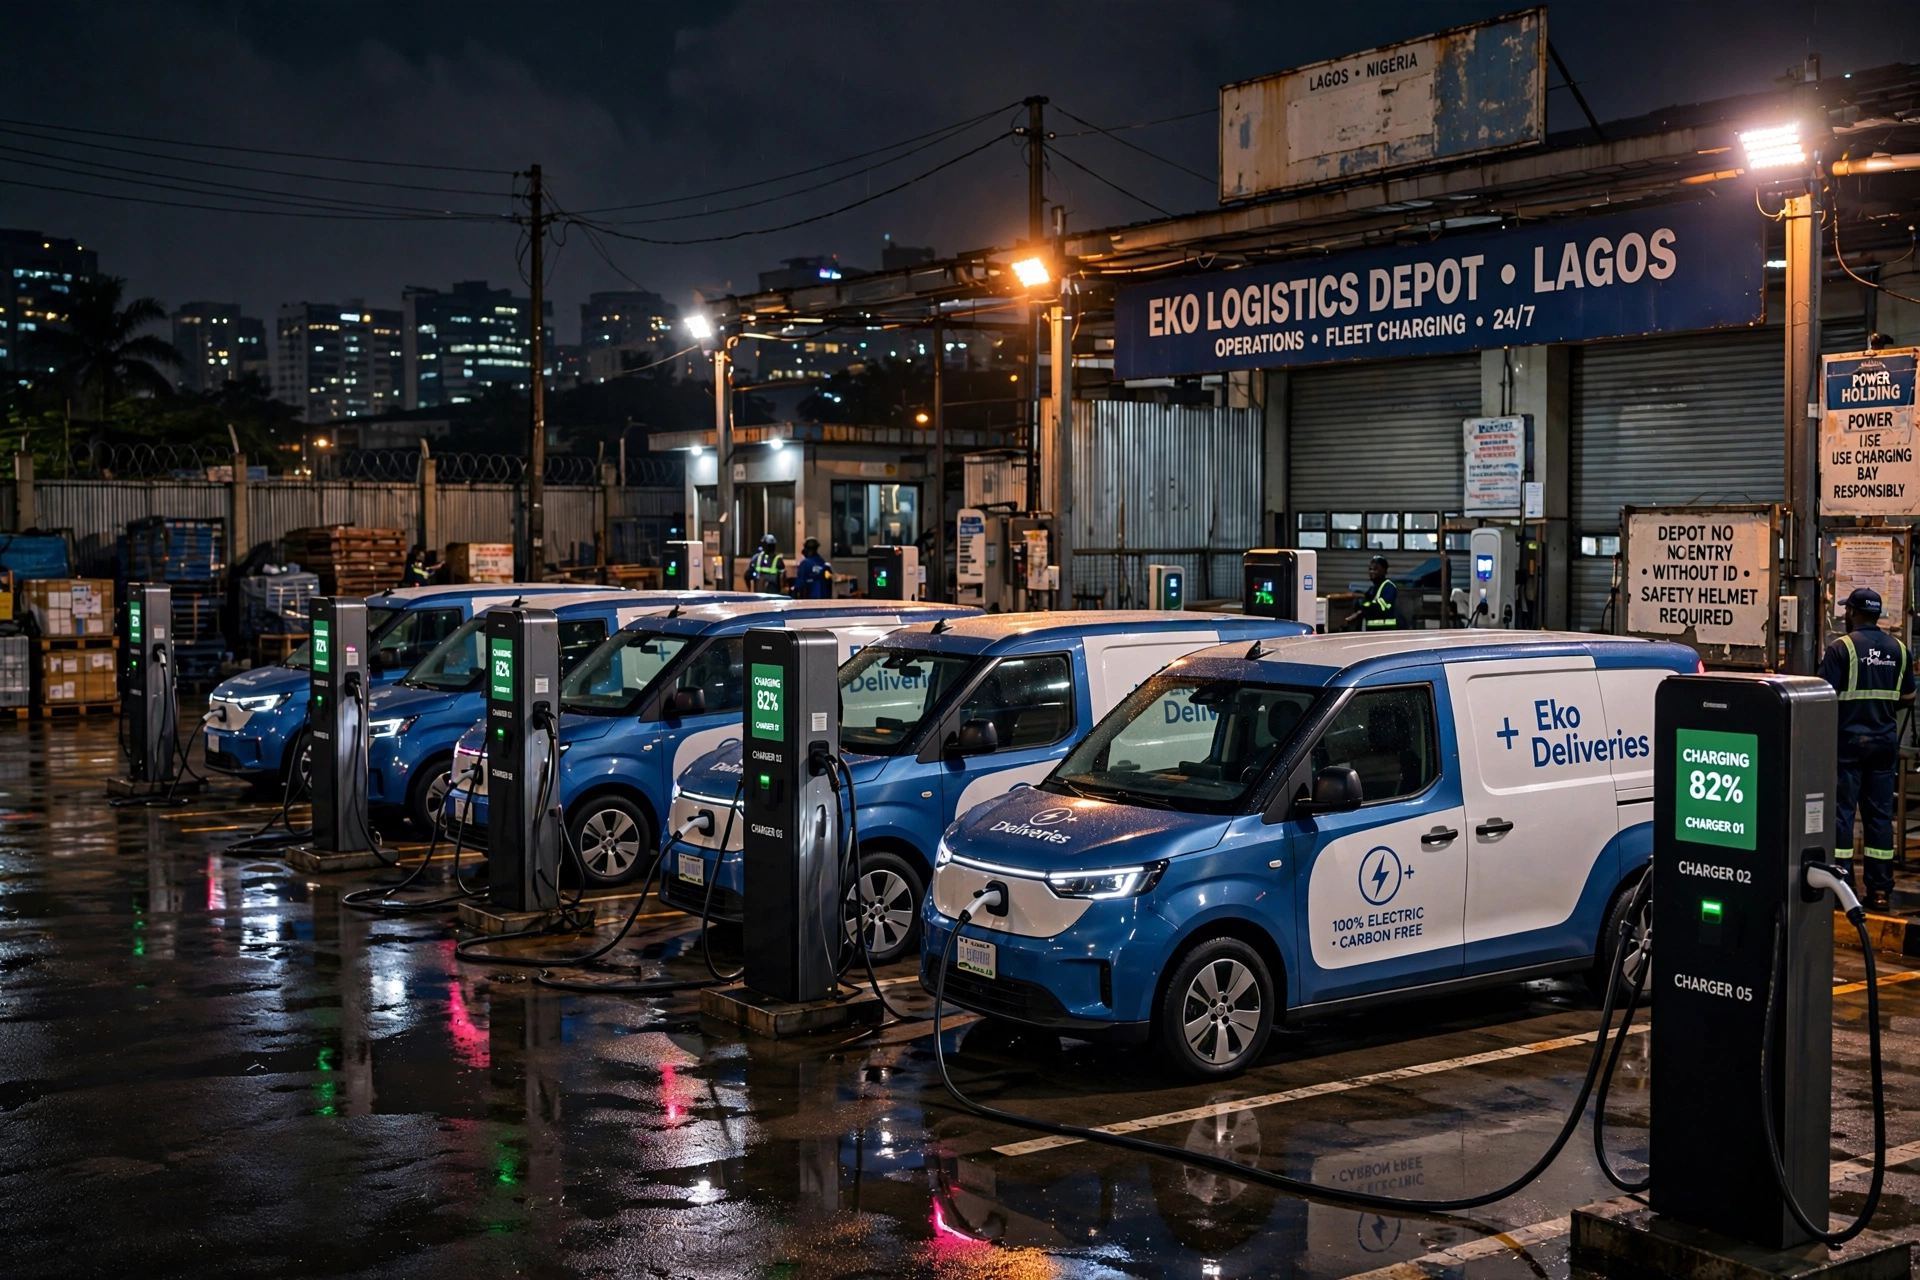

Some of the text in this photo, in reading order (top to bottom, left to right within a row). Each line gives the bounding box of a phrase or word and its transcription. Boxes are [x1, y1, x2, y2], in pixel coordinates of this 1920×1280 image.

[1309, 52, 1418, 91] LAGOS NIGERIA
[1149, 227, 1677, 337] EKO LOGISTICS DEPOT LAGOS
[1214, 304, 1536, 358] OPERATIONS FLEET CHARGING 24/7
[1852, 370, 1891, 388] POWER
[1841, 384, 1901, 403] HOLDING
[1848, 412, 1893, 430] POWER
[1832, 448, 1912, 465] USE CHARGING
[1857, 466, 1879, 481] BAY
[1833, 483, 1905, 499] RESPONSIBLY
[1658, 525, 1734, 541] DEPOT NO
[1652, 564, 1738, 582] WITHOUT ID
[1641, 586, 1758, 605] SAFETY HELMET
[1659, 607, 1734, 626] REQUIRED
[849, 669, 931, 693] Deliveri
[757, 690, 779, 711] 82%
[1534, 698, 1581, 731] Eko
[1531, 728, 1650, 768] Deliveries
[1682, 748, 1750, 768] CHARGING
[1689, 770, 1744, 804] 82%
[989, 820, 1071, 844] Deliveries
[1685, 816, 1744, 835] CHARGER 01
[1678, 860, 1752, 884] CHARGER 02
[1332, 906, 1424, 933] 100% ELECTRIC
[1339, 923, 1423, 949] CARBON FREE
[1674, 973, 1753, 1002] CHARGER 05
